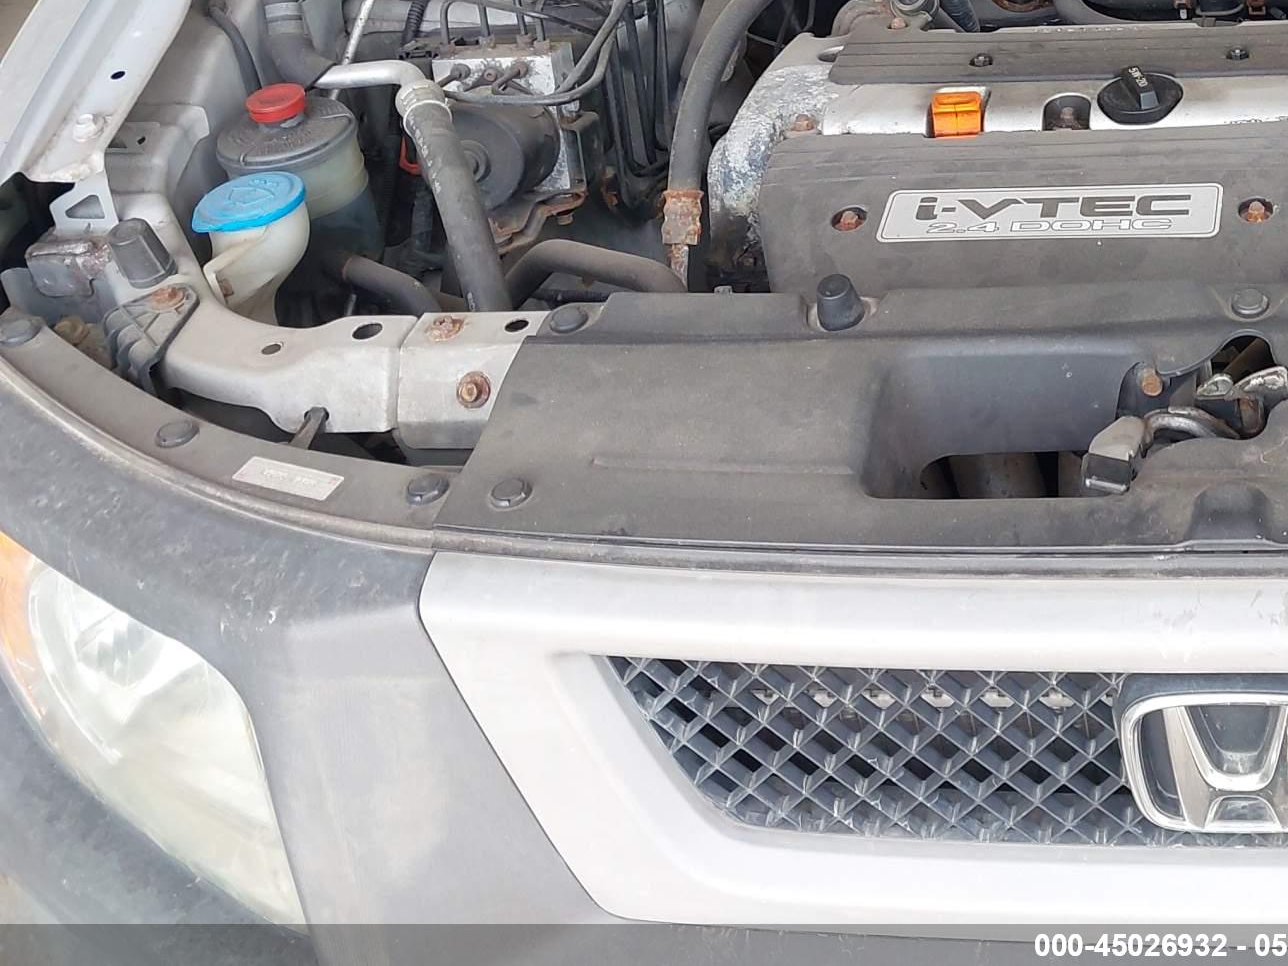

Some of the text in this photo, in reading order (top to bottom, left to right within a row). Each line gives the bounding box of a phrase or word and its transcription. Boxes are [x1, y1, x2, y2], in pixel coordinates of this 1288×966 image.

[915, 194, 1192, 221] i-VTEC
[926, 218, 1174, 234] 2.4 DOHC
